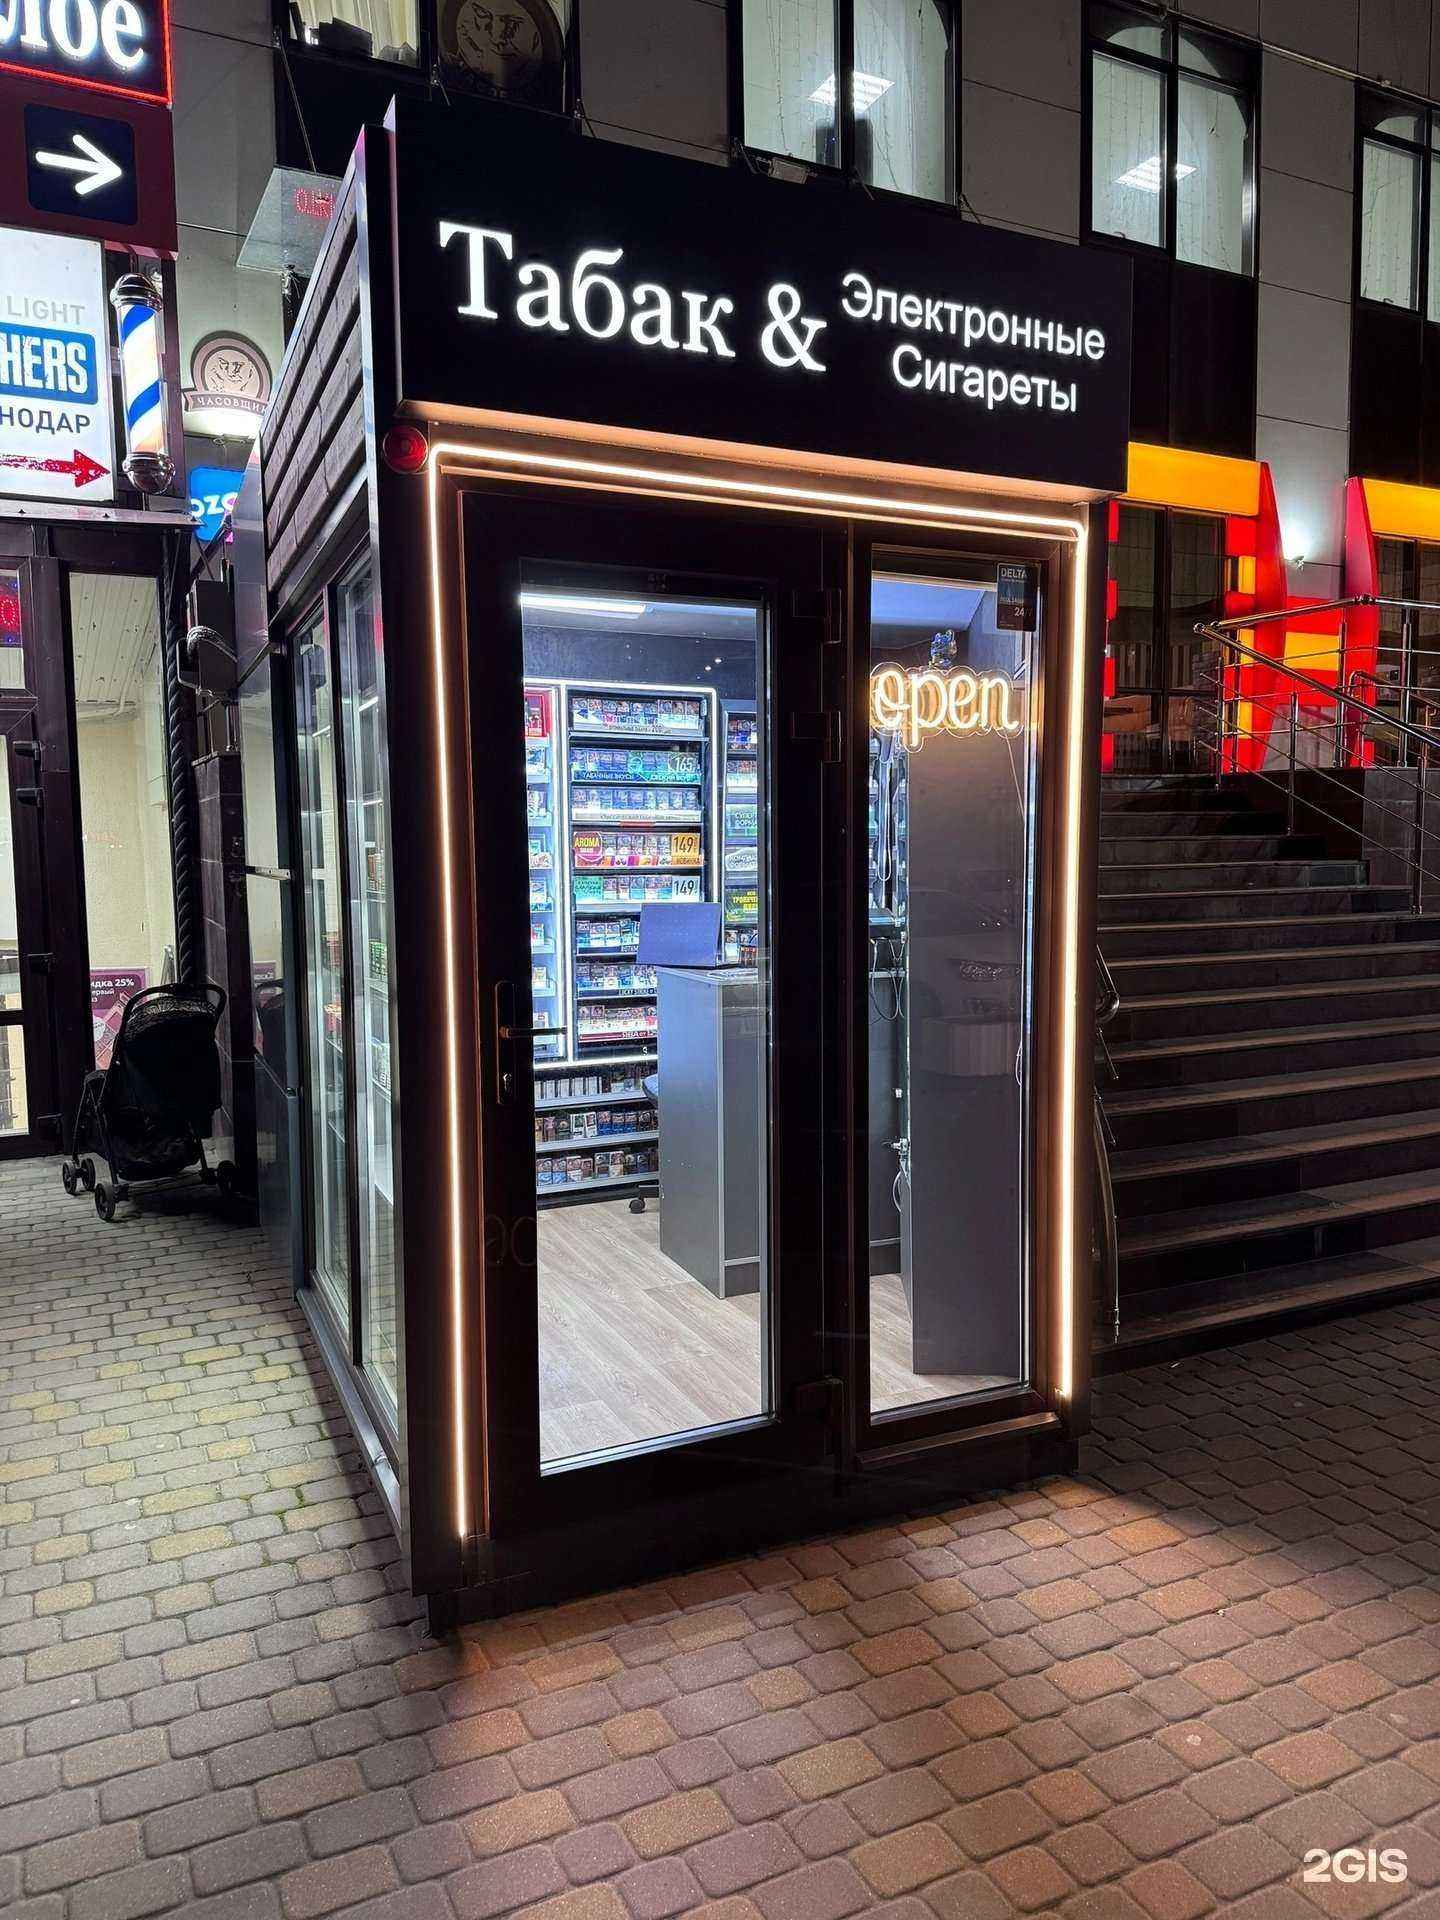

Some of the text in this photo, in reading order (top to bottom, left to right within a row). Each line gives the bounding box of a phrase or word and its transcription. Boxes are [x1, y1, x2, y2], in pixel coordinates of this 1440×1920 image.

[7, 295, 85, 325] LIGHT
[438, 220, 829, 373] Табак &
[840, 271, 1107, 361] Электронные
[891, 343, 1079, 413] Сигареты
[872, 670, 1019, 748] open
[673, 836, 694, 853] 149
[673, 879, 695, 896] 149
[114, 978, 135, 987] 25%
